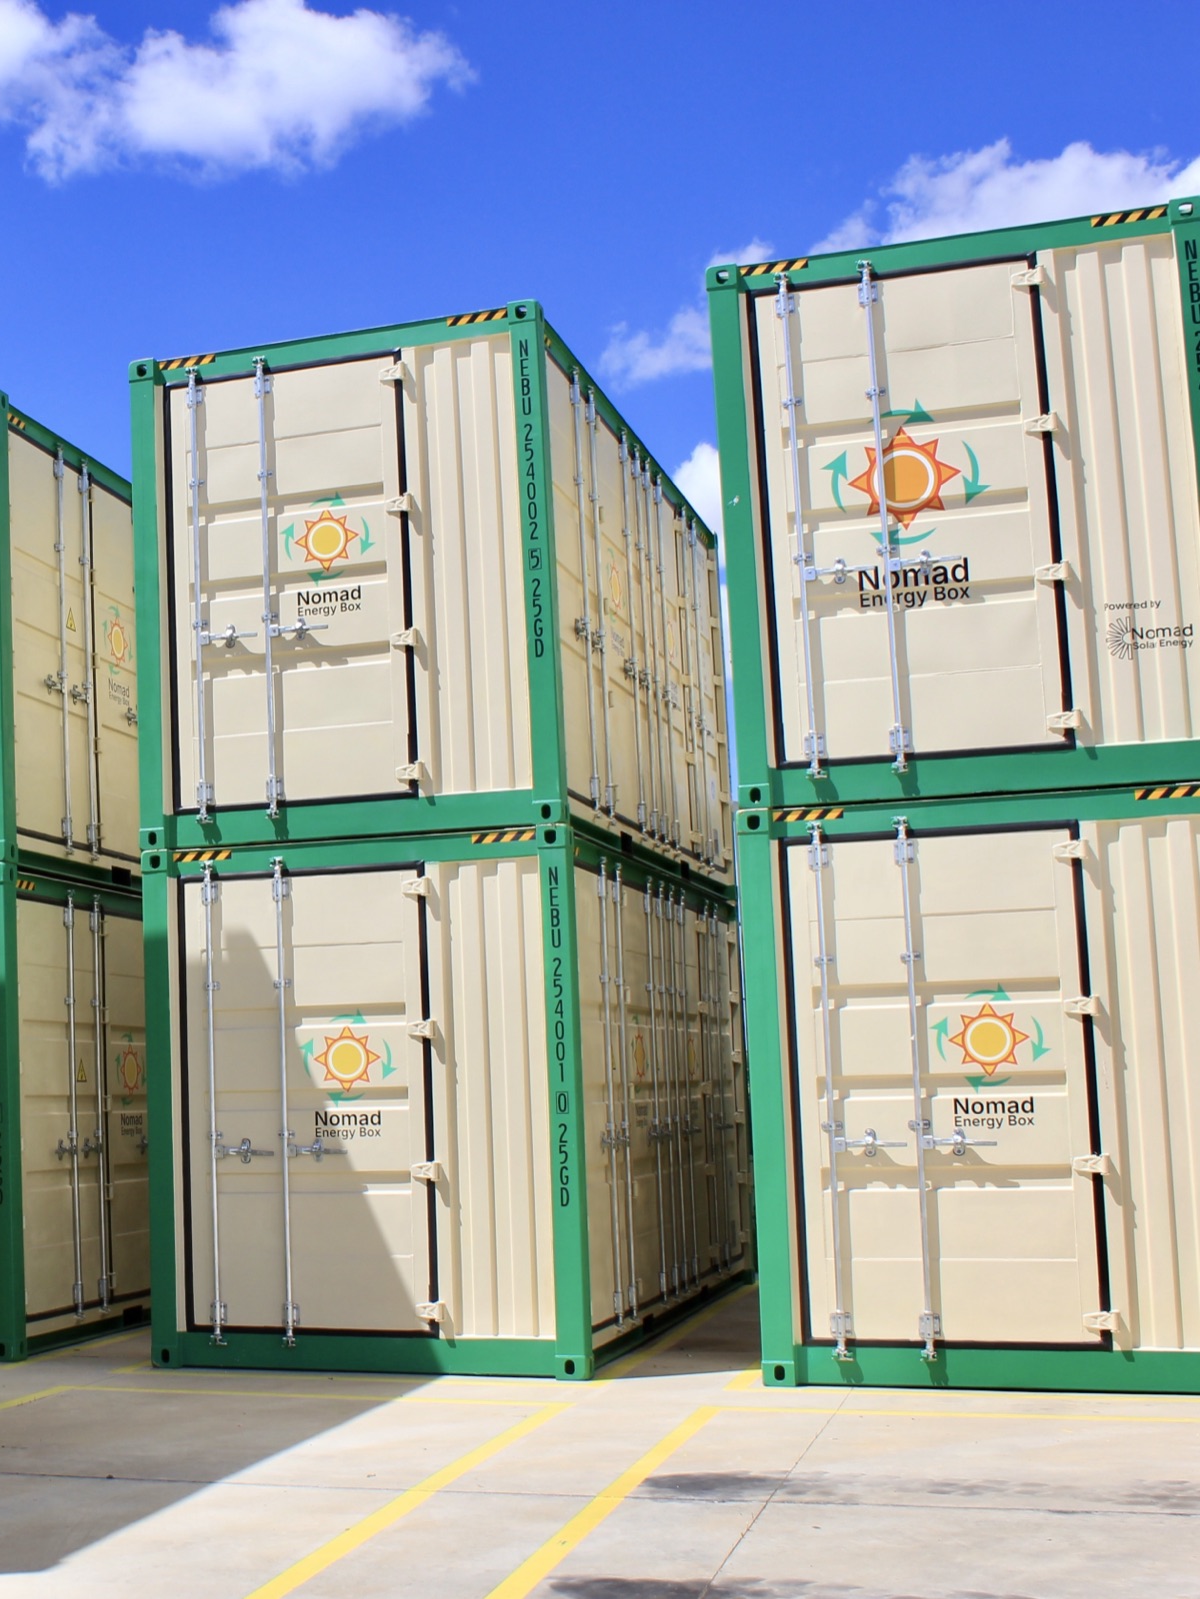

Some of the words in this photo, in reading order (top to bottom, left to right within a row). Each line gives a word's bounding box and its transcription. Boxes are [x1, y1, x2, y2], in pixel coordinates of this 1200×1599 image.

[519, 339, 531, 416] NEBU
[524, 423, 538, 540] 254002
[530, 549, 540, 569] 5
[858, 557, 969, 591] Nomad
[297, 585, 361, 606] Nomad
[934, 586, 970, 601] Box
[298, 605, 337, 616] Energy
[340, 602, 361, 612] Box
[532, 579, 544, 657] 25GD
[1132, 624, 1193, 640] Nomad
[1133, 641, 1156, 650] Sola
[109, 678, 129, 698] Nomad
[549, 867, 561, 948] NEBU
[553, 958, 565, 1082] 254001
[557, 1092, 567, 1113] 0
[953, 1096, 1034, 1114] Nomad
[121, 1113, 142, 1126] Nomad
[315, 1110, 381, 1126] Nomad
[955, 1116, 1003, 1129] Energy
[1008, 1115, 1034, 1126] Box
[316, 1127, 355, 1140] Energy
[360, 1127, 381, 1137] Box
[558, 1123, 570, 1207] 25GD
